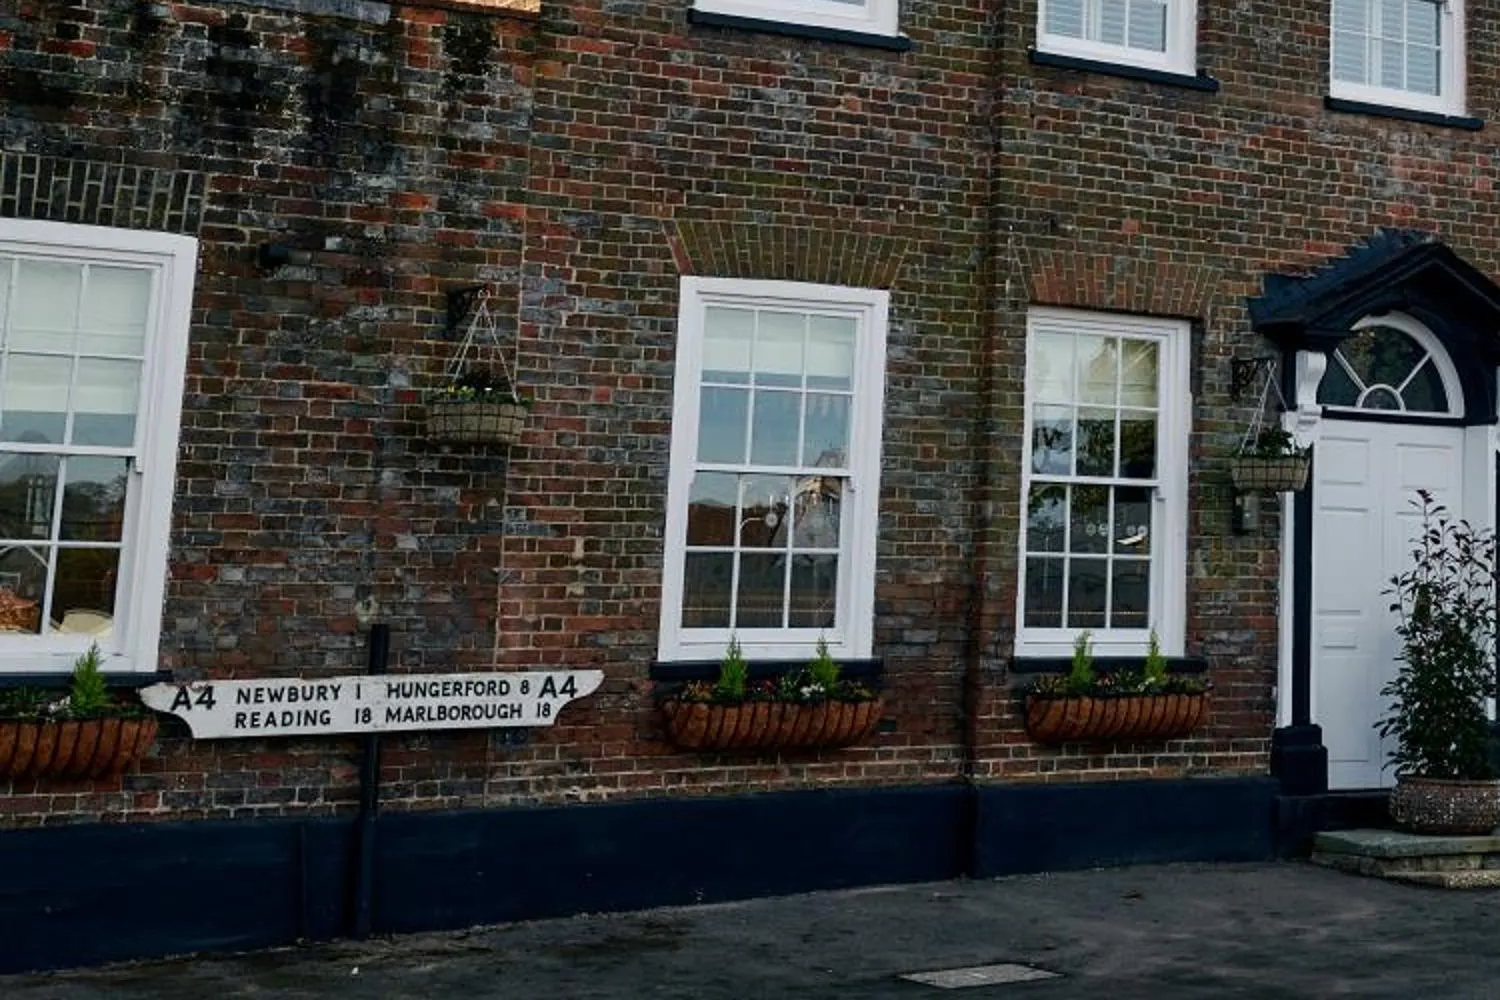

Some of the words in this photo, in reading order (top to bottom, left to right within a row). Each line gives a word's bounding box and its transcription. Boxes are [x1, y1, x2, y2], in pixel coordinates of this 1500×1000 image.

[236, 684, 342, 704] NEWBURY
[387, 680, 510, 698] HUNGERFORD
[520, 680, 530, 695] 8
[538, 675, 578, 698] A4
[171, 685, 216, 710] A4
[235, 710, 332, 728] READING
[355, 707, 372, 724] 18
[385, 704, 523, 723] MARLBOROUGH
[537, 703, 551, 718] 18
